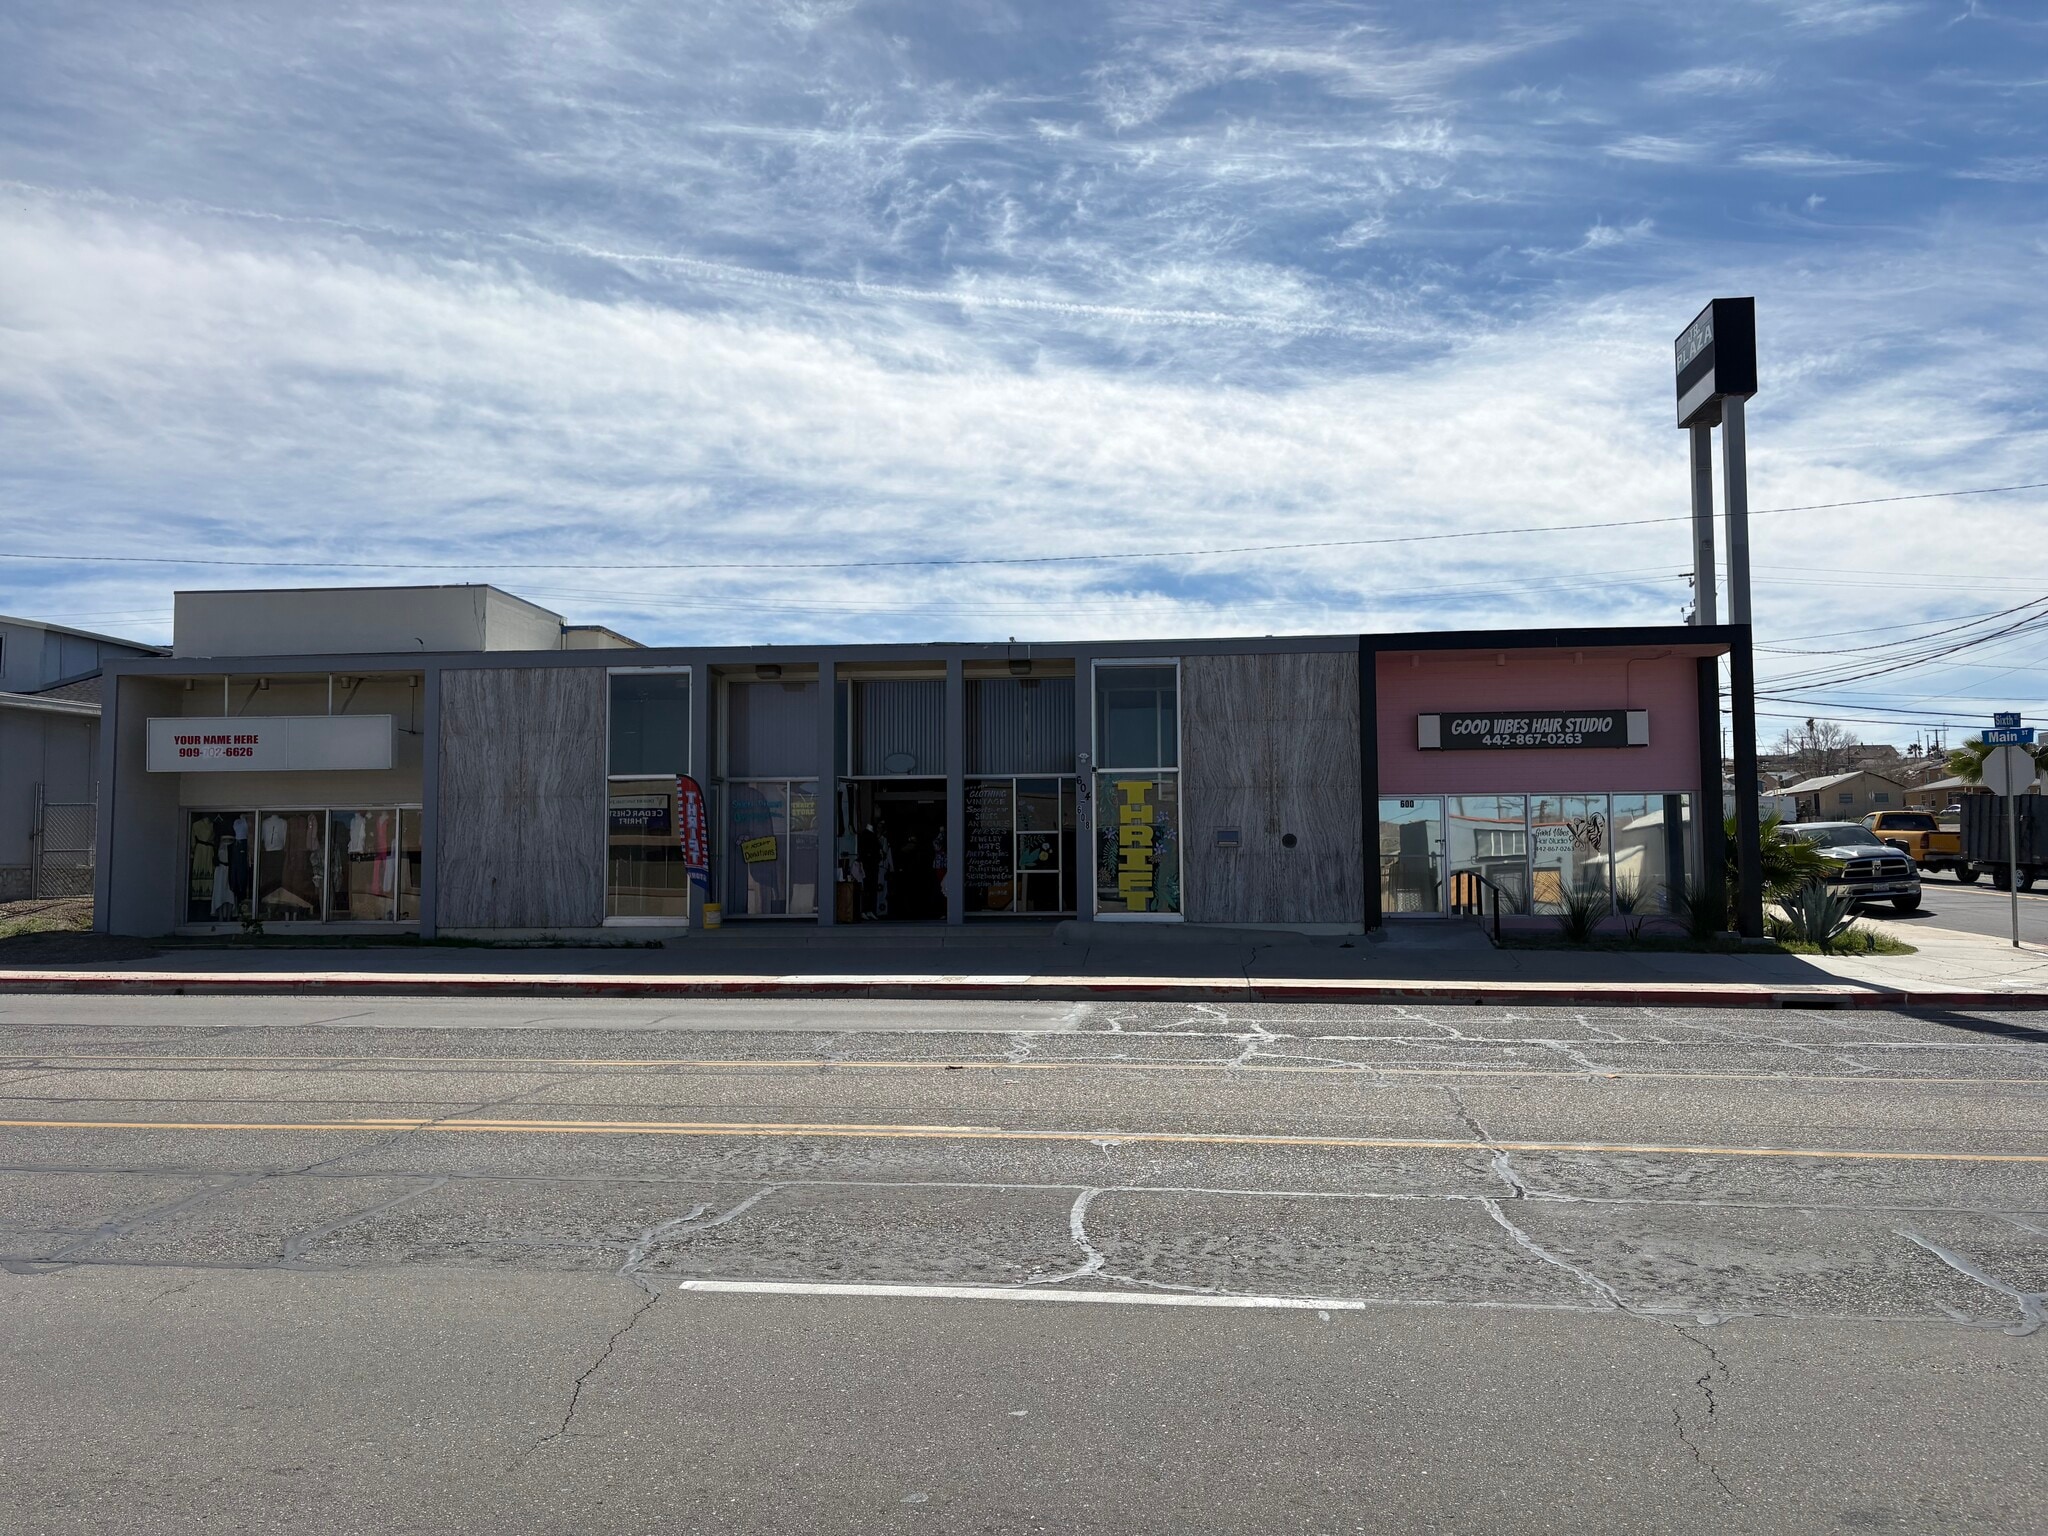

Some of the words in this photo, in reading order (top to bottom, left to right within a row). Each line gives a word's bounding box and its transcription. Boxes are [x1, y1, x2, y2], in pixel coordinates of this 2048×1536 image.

[1676, 324, 1713, 372] PLAZA
[1451, 719, 1490, 735] GOOD
[1493, 718, 1529, 734] VIBES
[1531, 717, 1562, 733] HAIR
[1565, 717, 1613, 732] STUDIO
[1995, 715, 2014, 726] Sixth
[174, 735, 201, 745] YOUR
[203, 735, 232, 745] NAME
[233, 735, 259, 744] HERE
[1482, 733, 1583, 746] 442-867-0263
[1988, 731, 2018, 743] Main
[969, 790, 1007, 798] CLOTHING
[1400, 799, 1414, 808] 600
[1117, 781, 1154, 911] THRIFT
